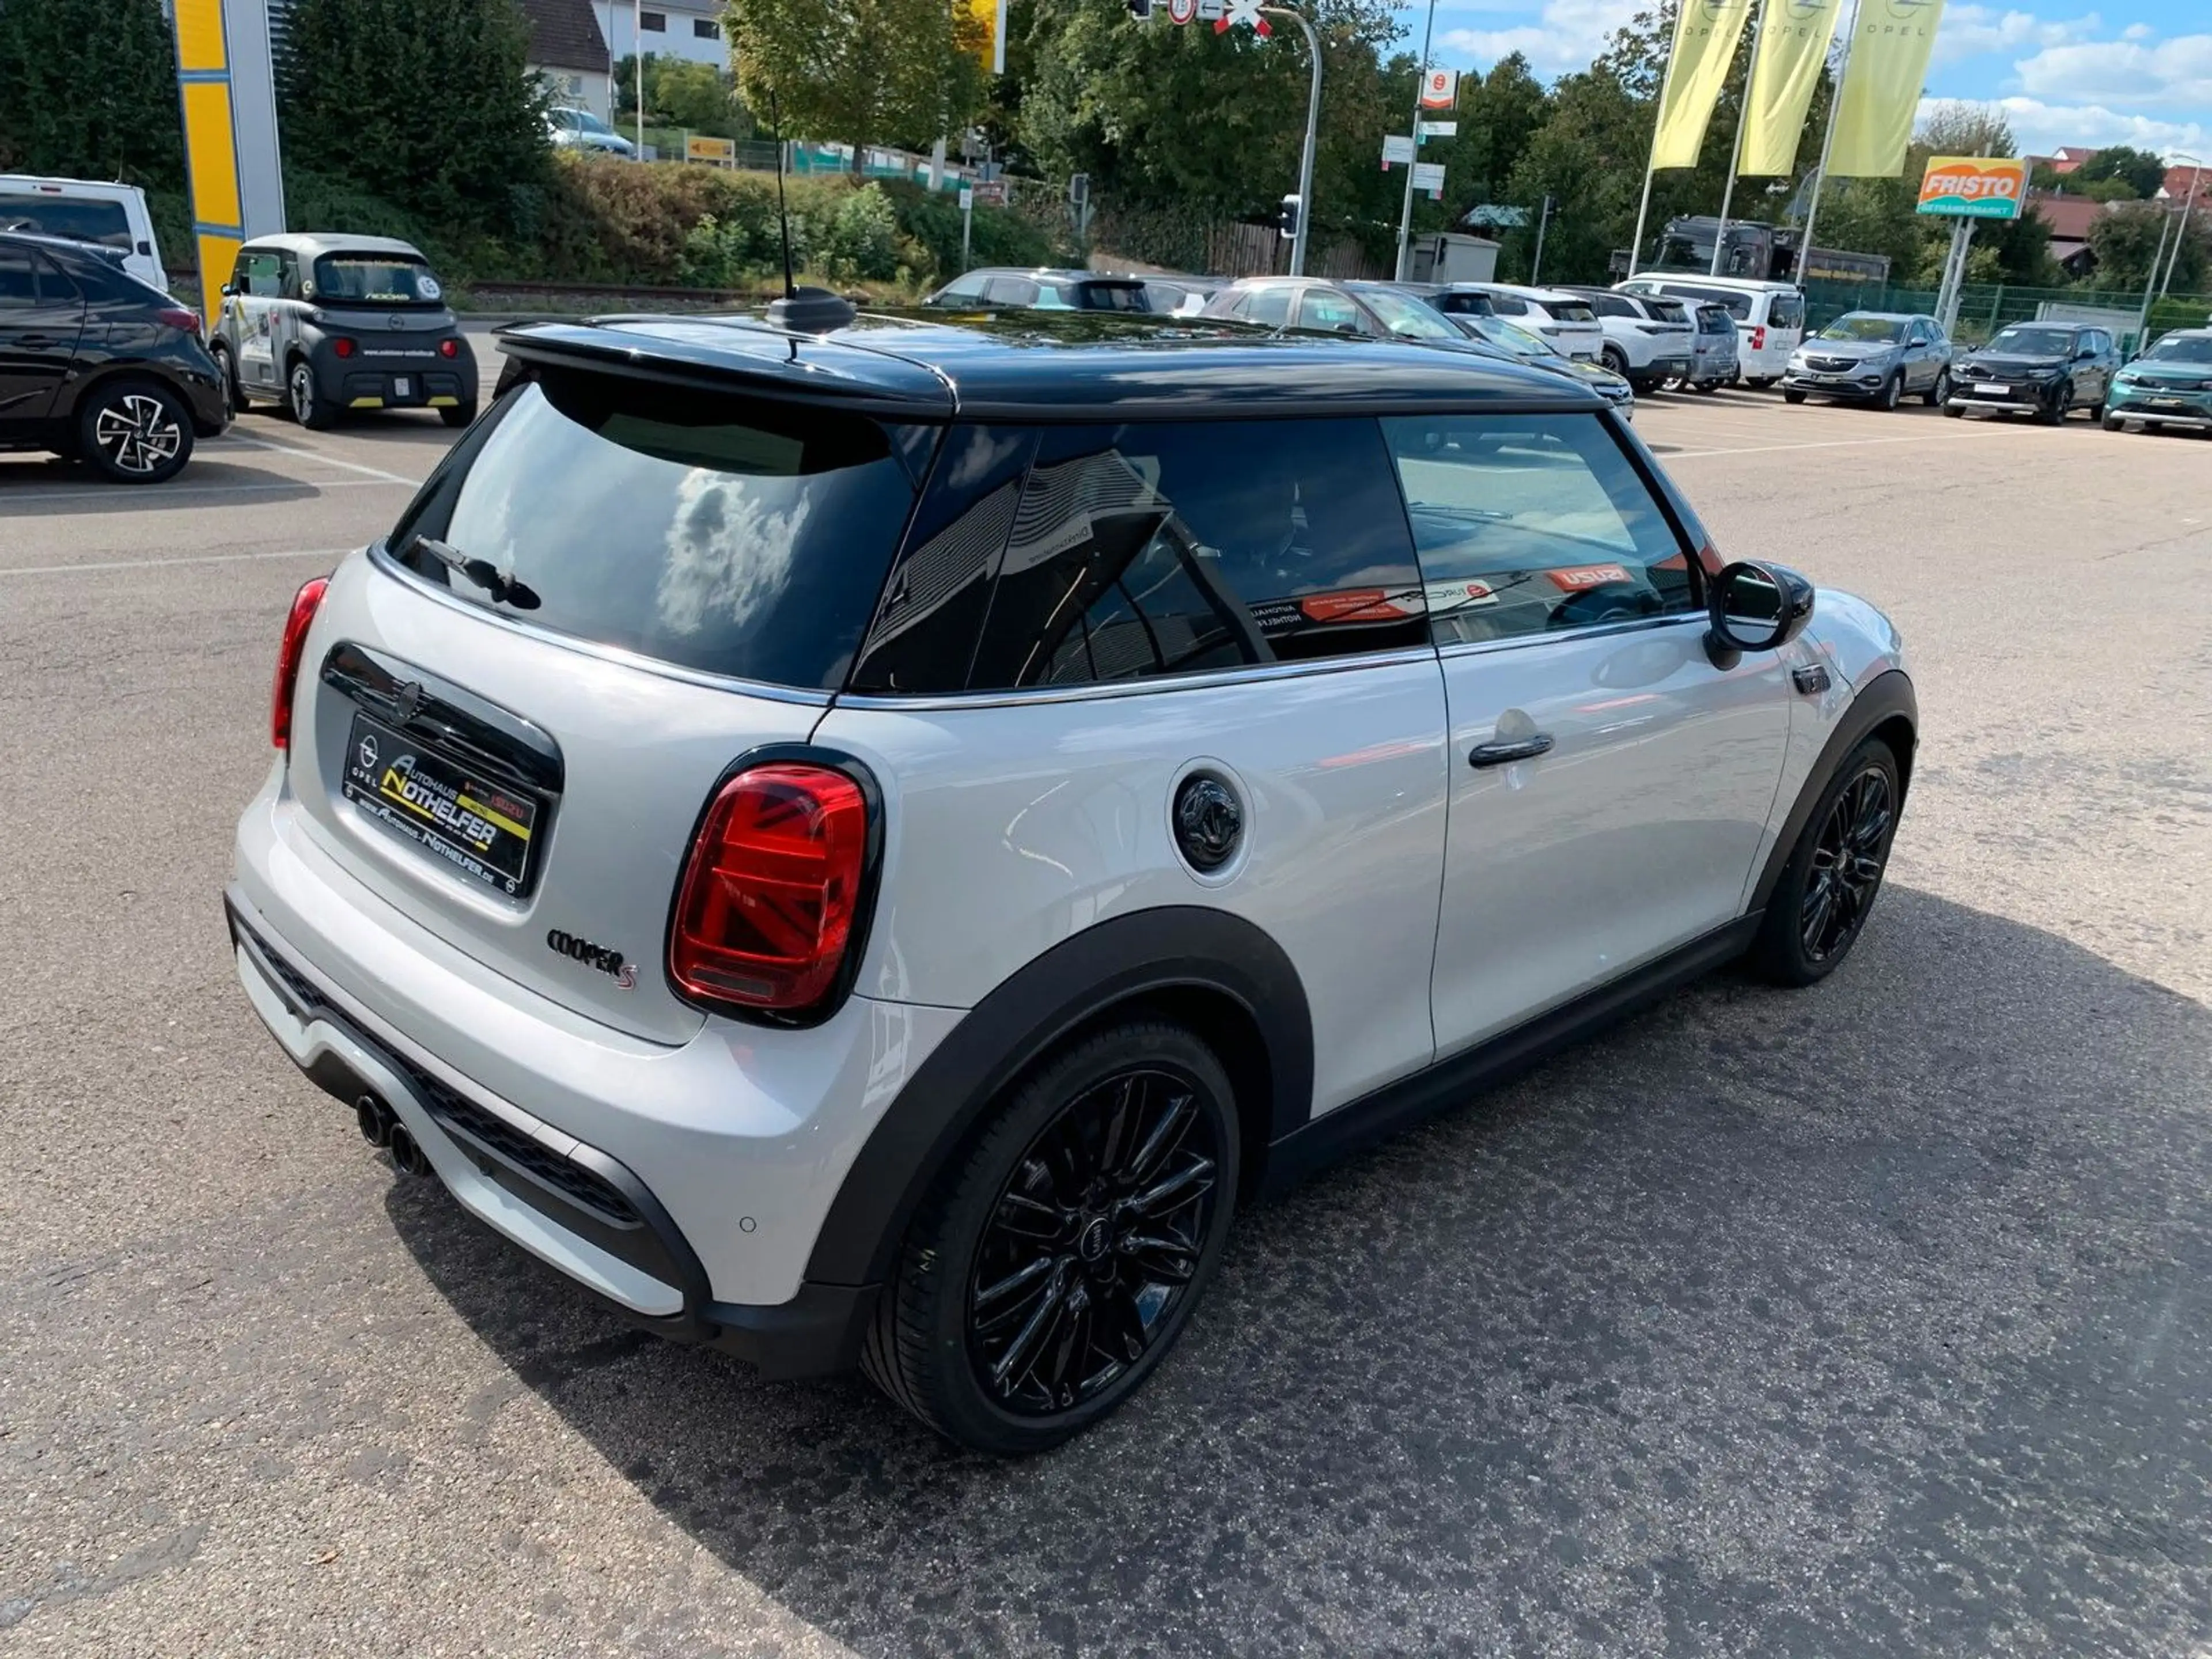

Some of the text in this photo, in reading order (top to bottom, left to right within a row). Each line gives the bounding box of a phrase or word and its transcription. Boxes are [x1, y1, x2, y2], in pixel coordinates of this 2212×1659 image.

[1684, 26, 1733, 37] OPEL
[1768, 25, 1820, 38] OPEL
[1867, 24, 1925, 36] OPEL
[1925, 175, 2014, 196] FRISTO
[352, 767, 377, 787] OPEL
[391, 754, 459, 801] AUTOHAUS
[382, 768, 497, 845] NOTHELFER
[547, 929, 638, 990] COOPER S
